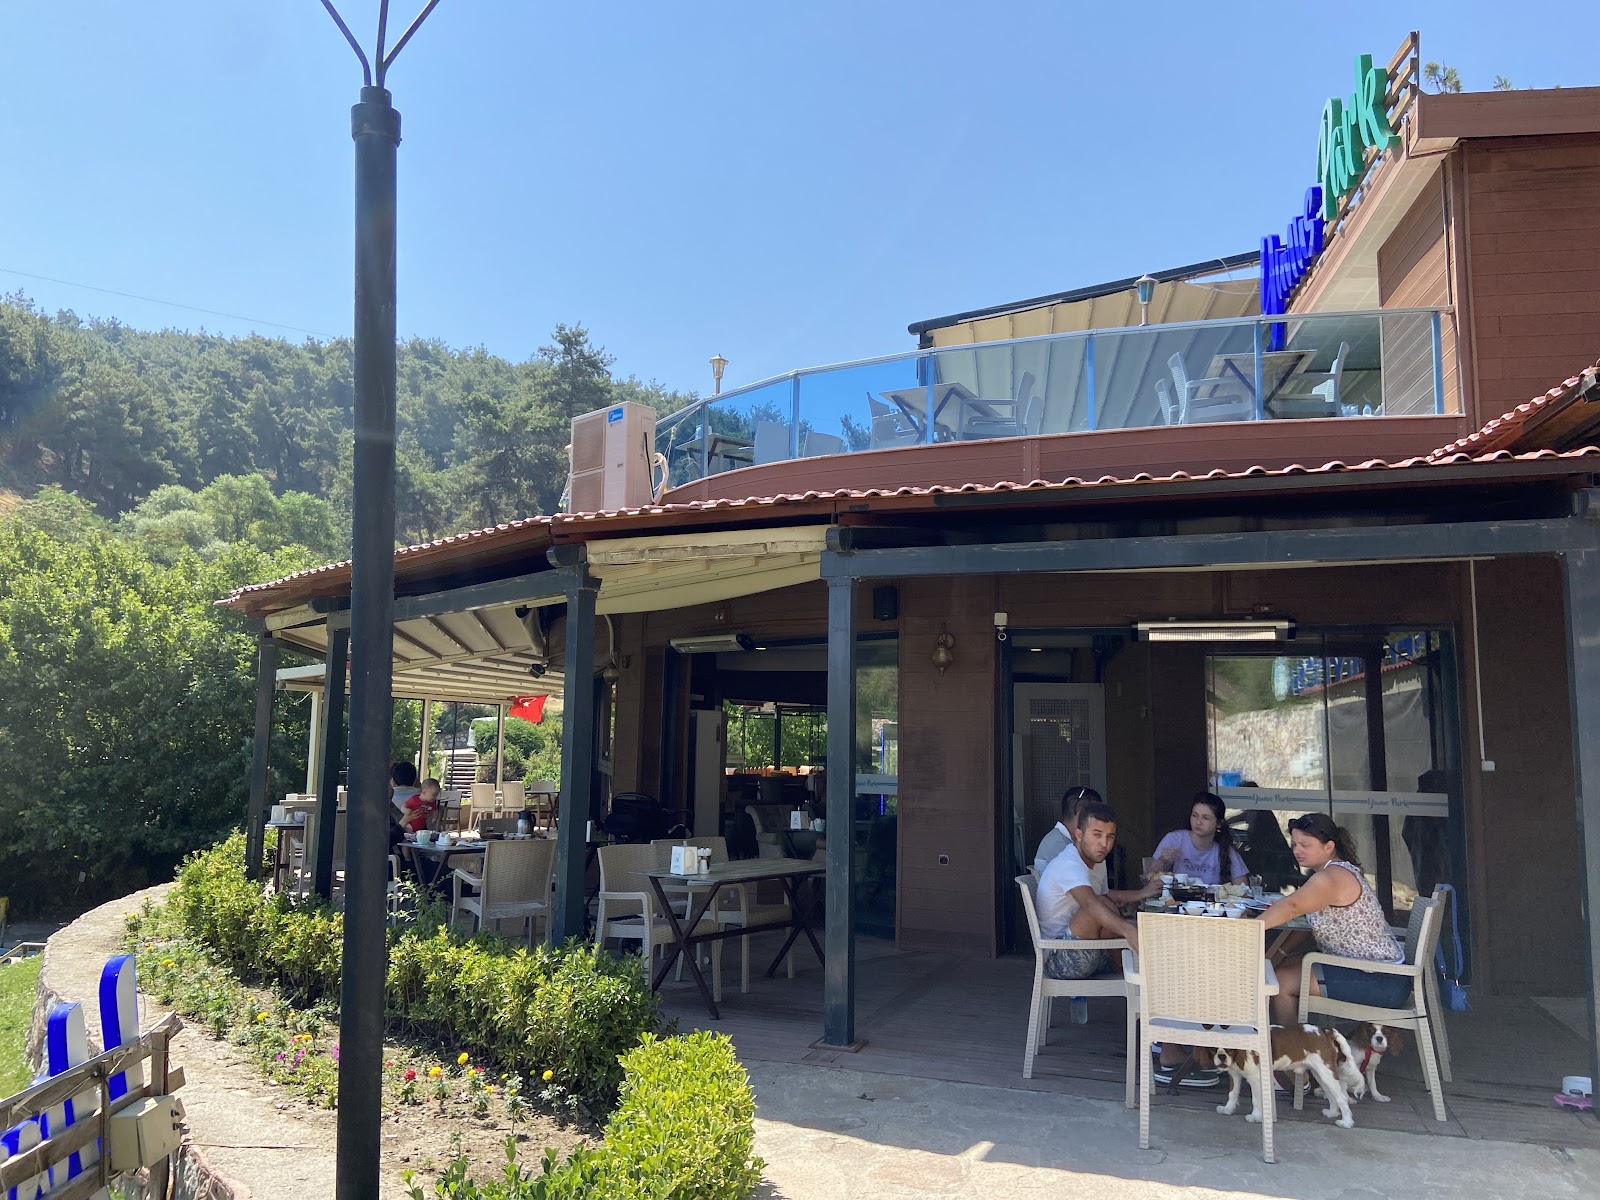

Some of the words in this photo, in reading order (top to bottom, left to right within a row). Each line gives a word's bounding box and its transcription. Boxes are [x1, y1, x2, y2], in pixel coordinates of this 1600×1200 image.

[1317, 53, 1402, 222] Park
[1274, 793, 1293, 805] Park
[1390, 797, 1409, 808] Park
